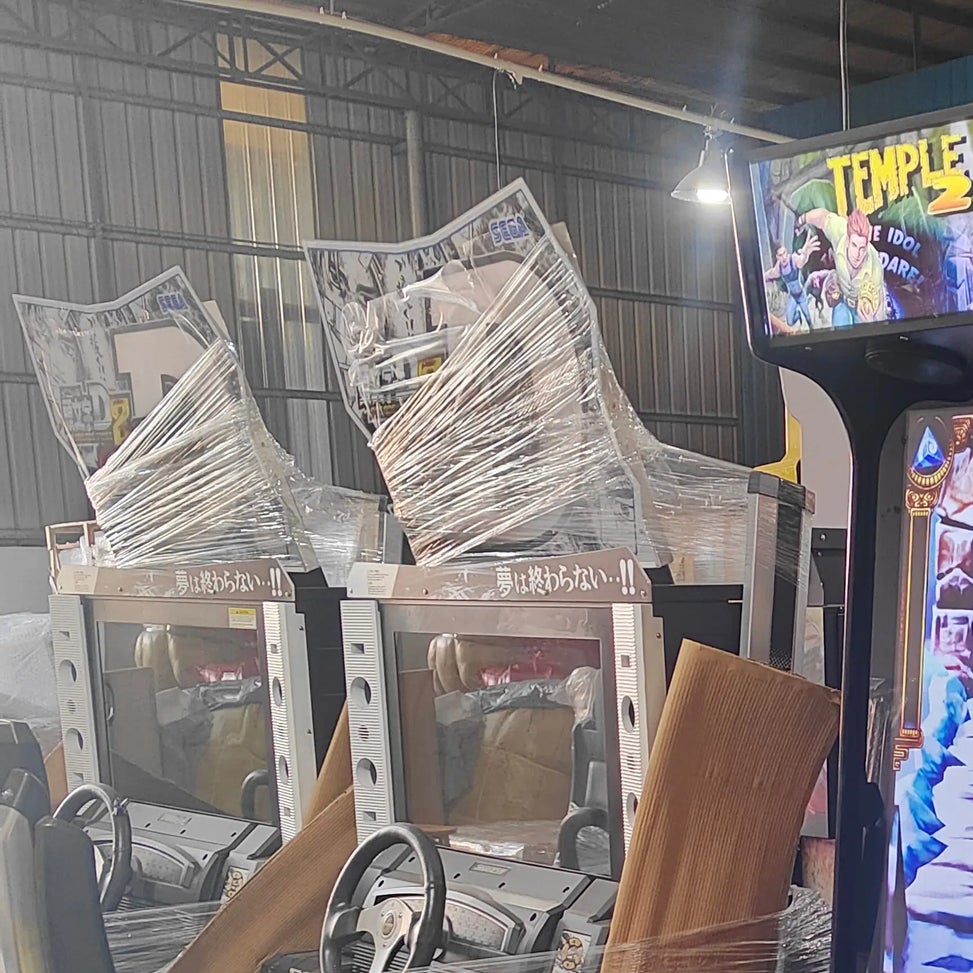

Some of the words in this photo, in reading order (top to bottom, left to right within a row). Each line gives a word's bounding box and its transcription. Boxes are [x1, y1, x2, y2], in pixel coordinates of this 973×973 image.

[826, 134, 969, 217] TEMPLE
[927, 174, 973, 215] 2
[488, 213, 532, 246] SEGA
[887, 226, 922, 258] IDOL
